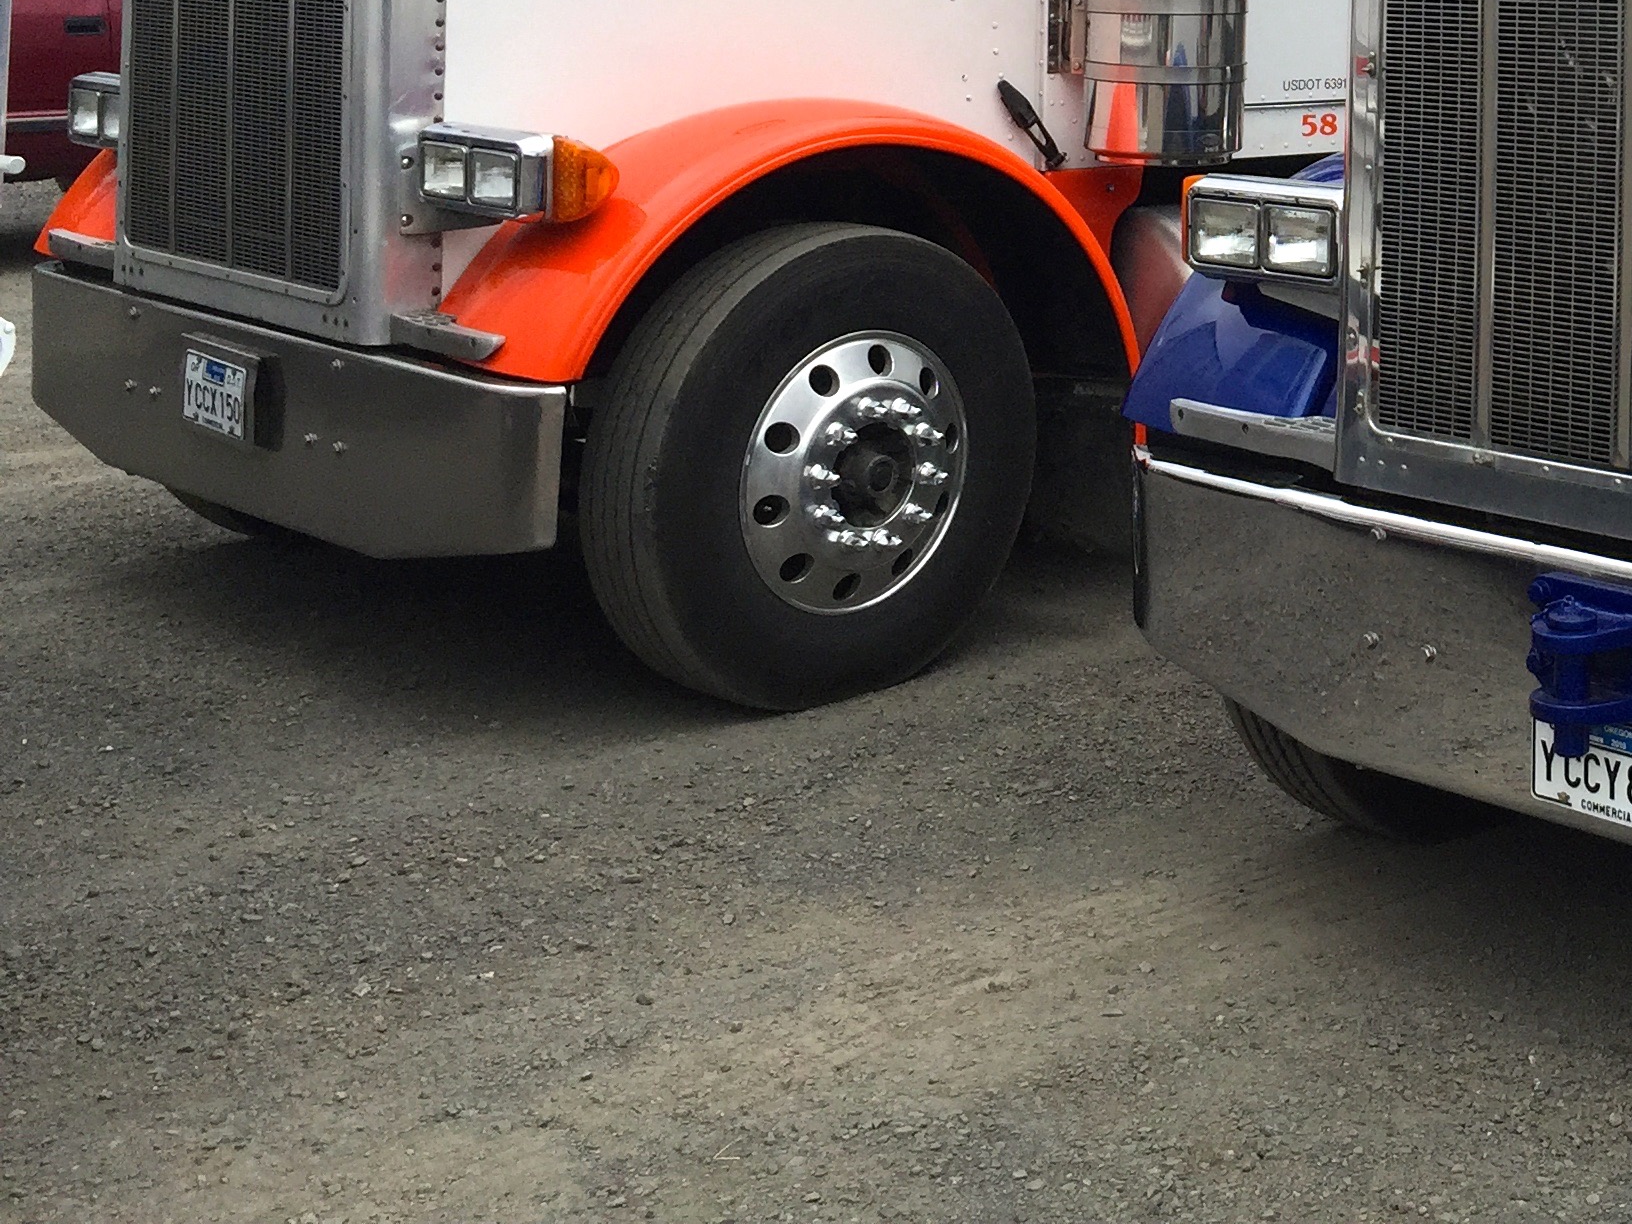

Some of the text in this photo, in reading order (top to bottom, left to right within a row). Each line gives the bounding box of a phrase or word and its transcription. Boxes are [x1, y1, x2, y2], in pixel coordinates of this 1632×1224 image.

[1282, 78, 1321, 91] USDOT
[1301, 113, 1338, 137] 58
[186, 377, 241, 425] YCCX150
